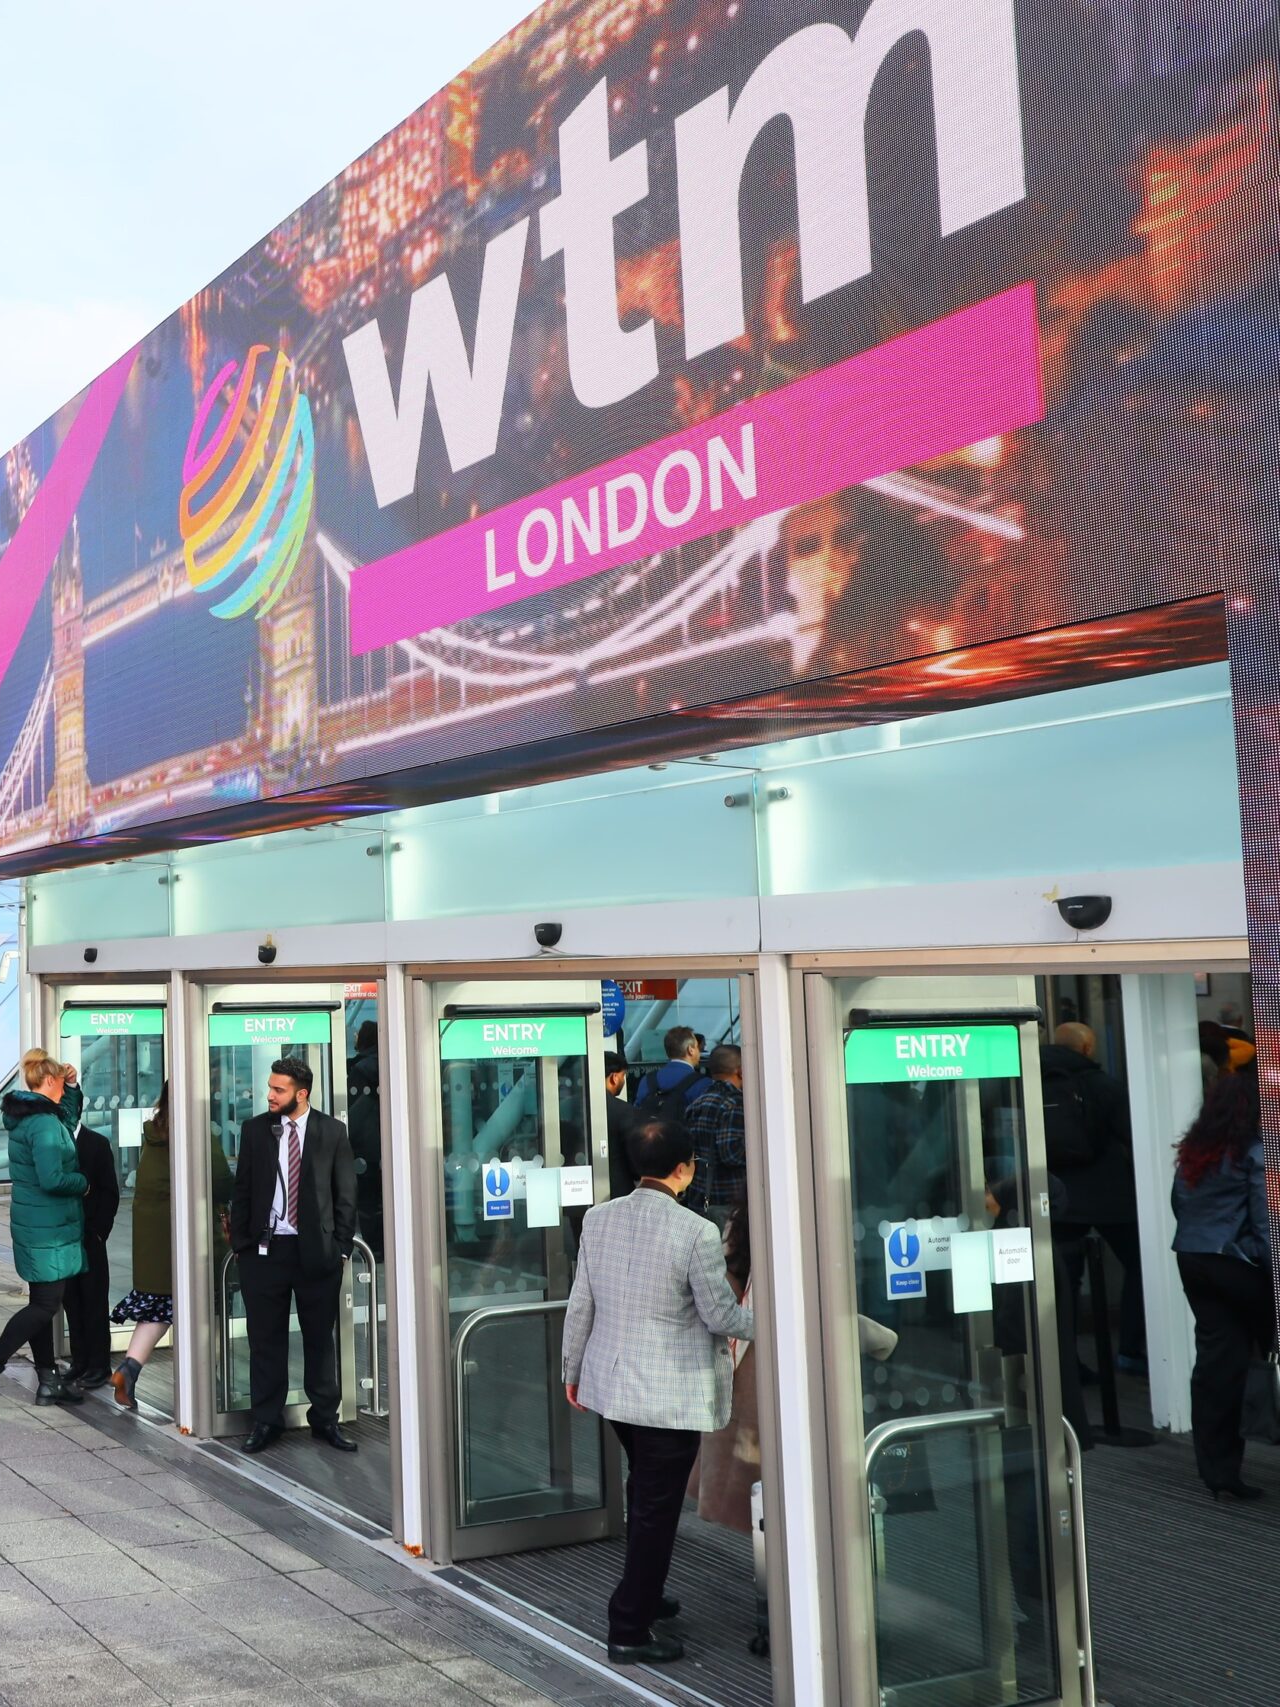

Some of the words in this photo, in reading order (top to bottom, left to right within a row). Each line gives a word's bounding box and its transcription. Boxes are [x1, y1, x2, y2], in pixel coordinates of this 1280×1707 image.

[342, 0, 1026, 508] wtm
[485, 424, 757, 592] LONDON
[616, 981, 643, 993] EXIT
[90, 1012, 134, 1025] ENTRY
[244, 1017, 296, 1032] ENTRY
[483, 1023, 546, 1041] ENTRY
[251, 1035, 290, 1043] Welcome
[491, 1046, 539, 1055] Welcome
[895, 1033, 971, 1059] ENTRY
[906, 1064, 963, 1078] Welcome
[928, 1236, 950, 1244] Automa
[936, 1245, 949, 1253] door
[998, 1247, 1028, 1255] Automatic
[1006, 1257, 1021, 1265] door
